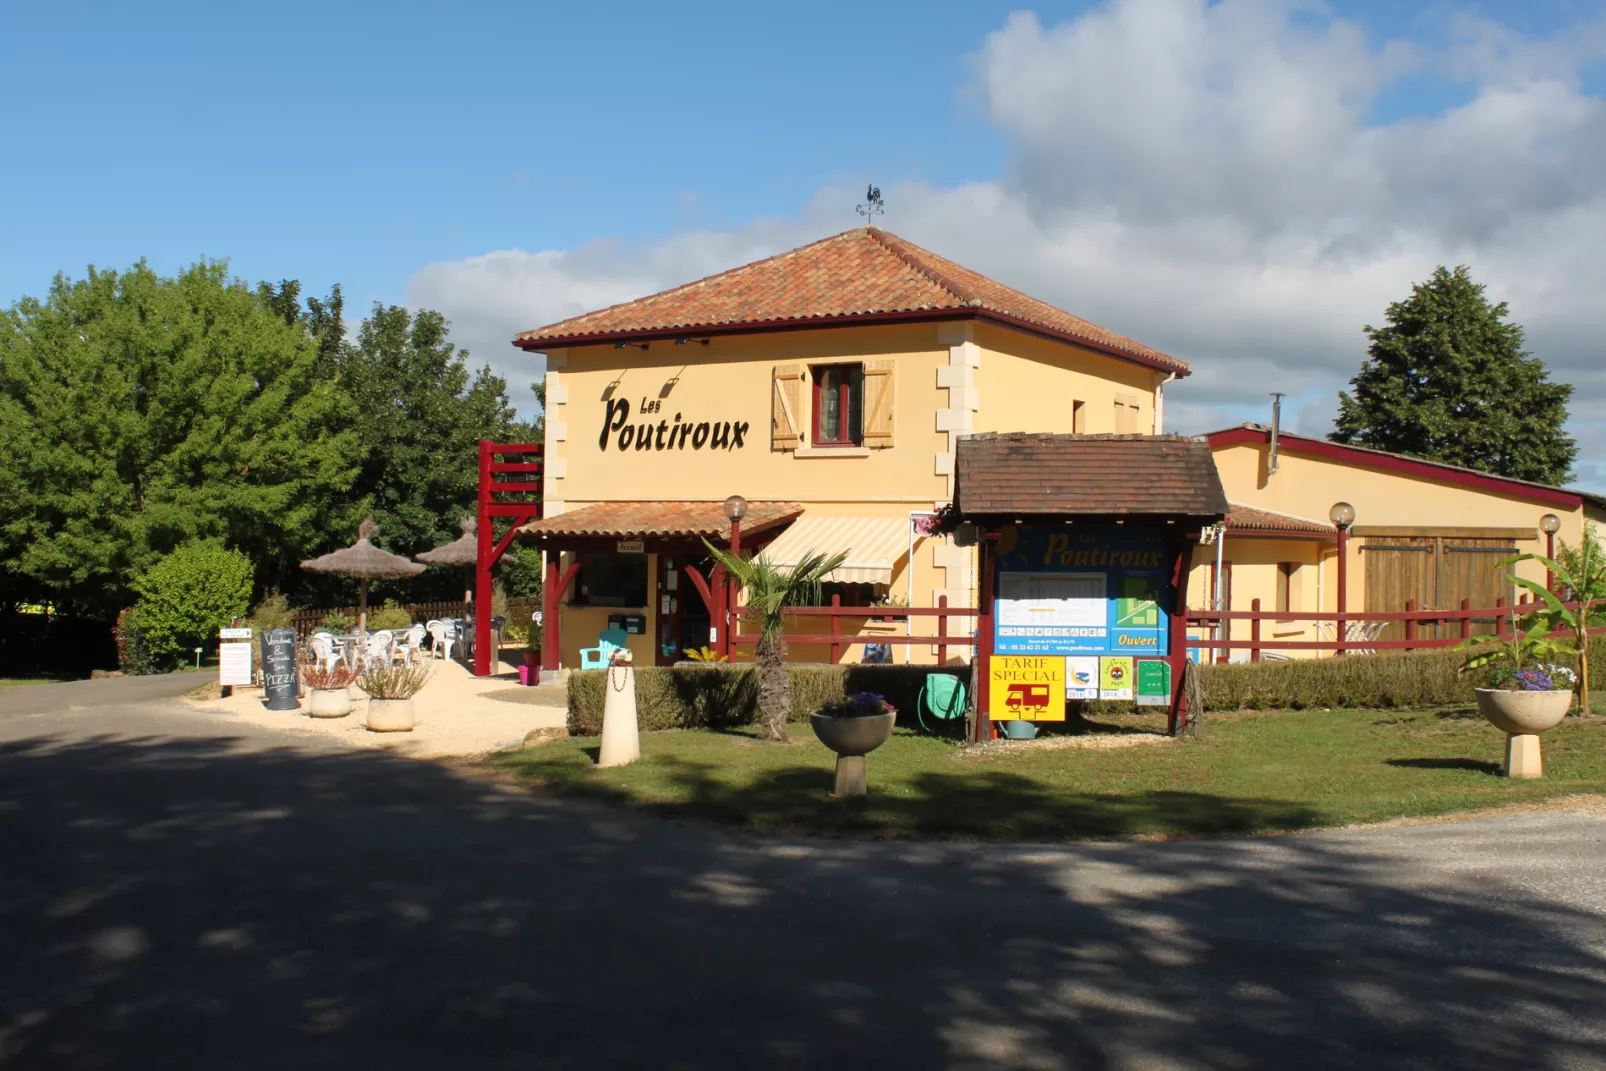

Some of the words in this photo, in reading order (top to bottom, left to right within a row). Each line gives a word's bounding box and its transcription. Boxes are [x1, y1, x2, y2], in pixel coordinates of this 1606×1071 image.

[640, 396, 661, 414] Les
[599, 397, 749, 452] Poutiroux
[1043, 533, 1162, 568] Poutiroux
[1118, 634, 1157, 646] Ouvert
[274, 645, 284, 655] &
[1001, 657, 1048, 669] TARIF
[994, 670, 1061, 681] SPECIAL
